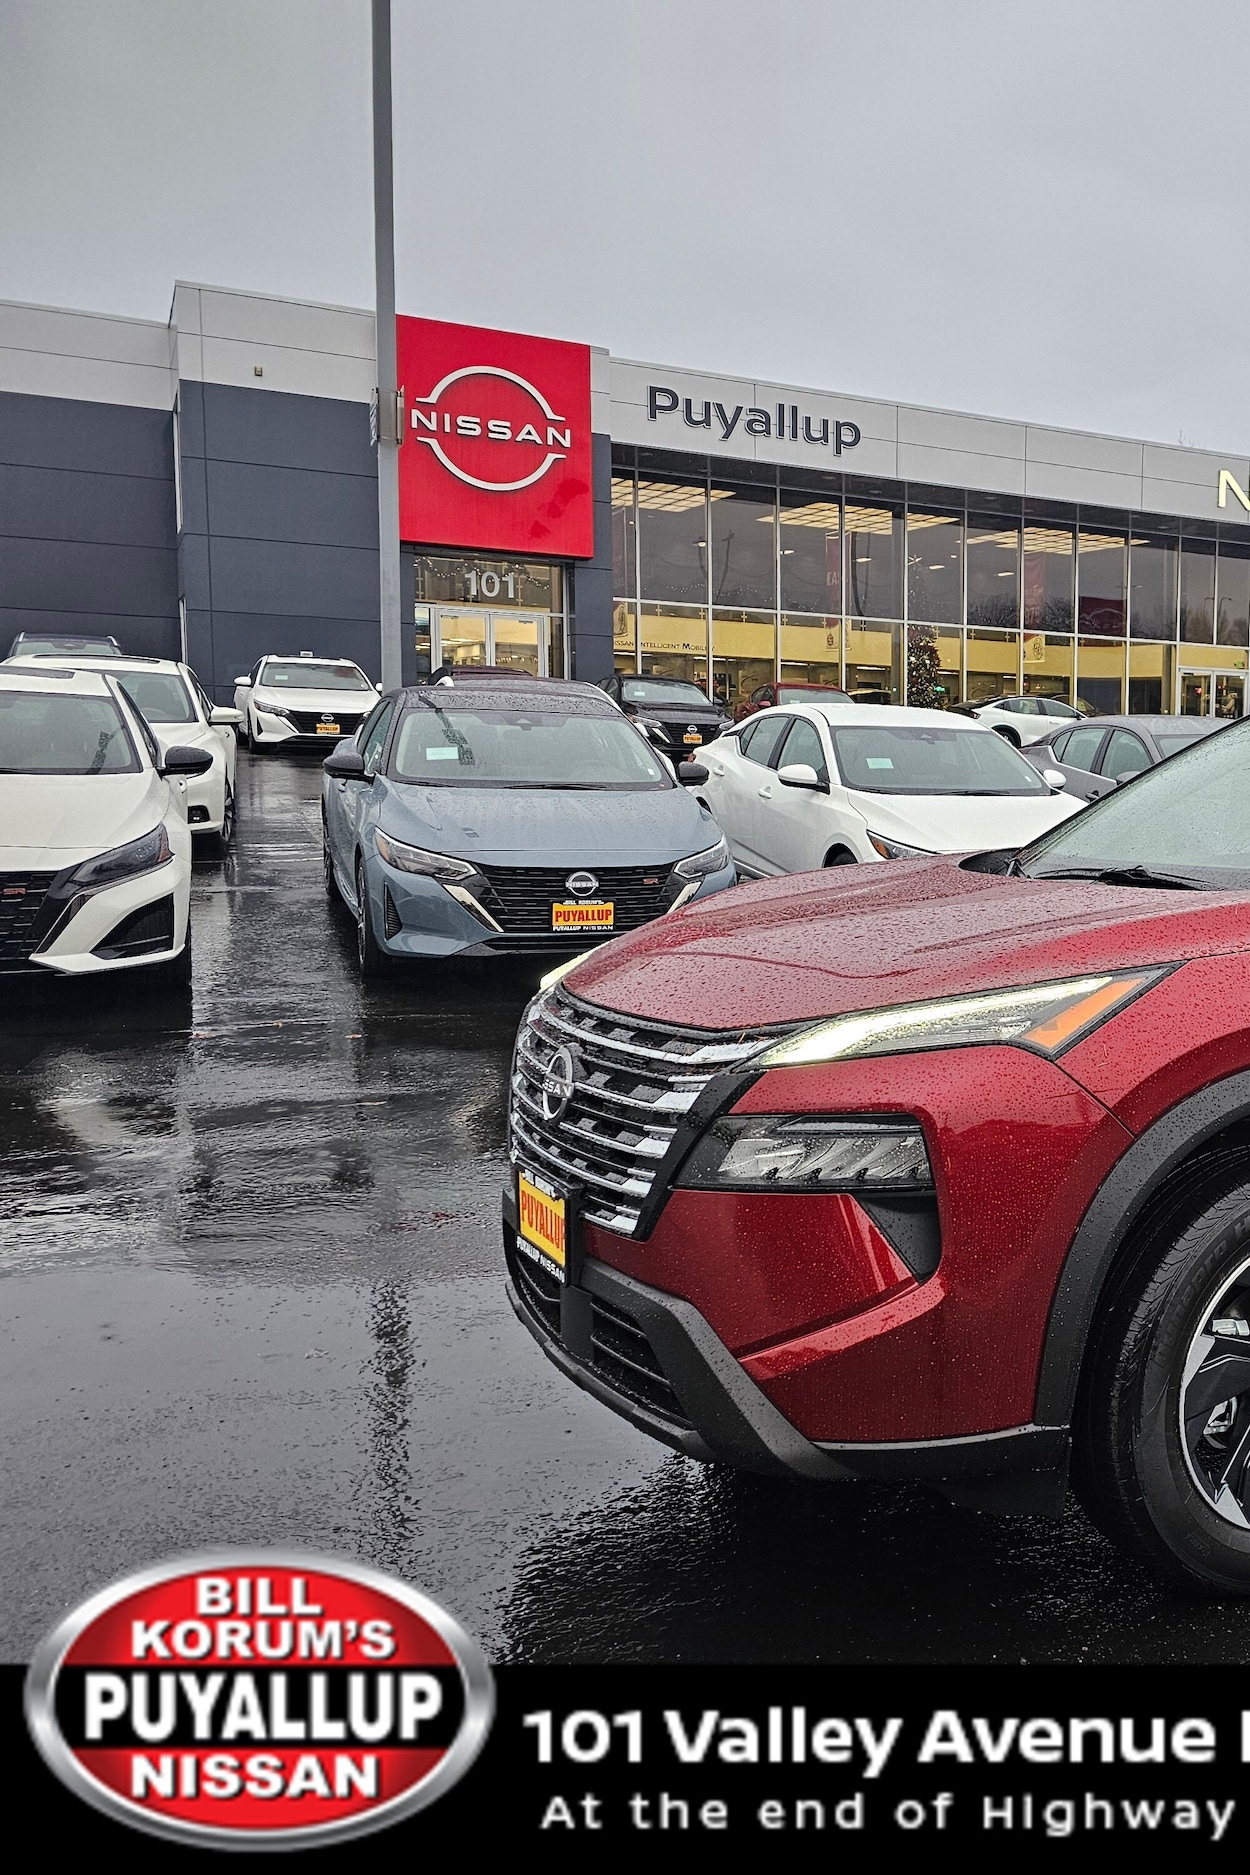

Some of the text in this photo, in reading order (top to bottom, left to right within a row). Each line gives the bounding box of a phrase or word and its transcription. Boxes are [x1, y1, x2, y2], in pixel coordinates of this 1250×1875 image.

[411, 408, 571, 448] NISSAN
[646, 384, 861, 456] Puyallup
[464, 570, 514, 598] 101
[554, 909, 612, 923] PUYALLUP
[521, 1189, 567, 1253] PUYALLUP
